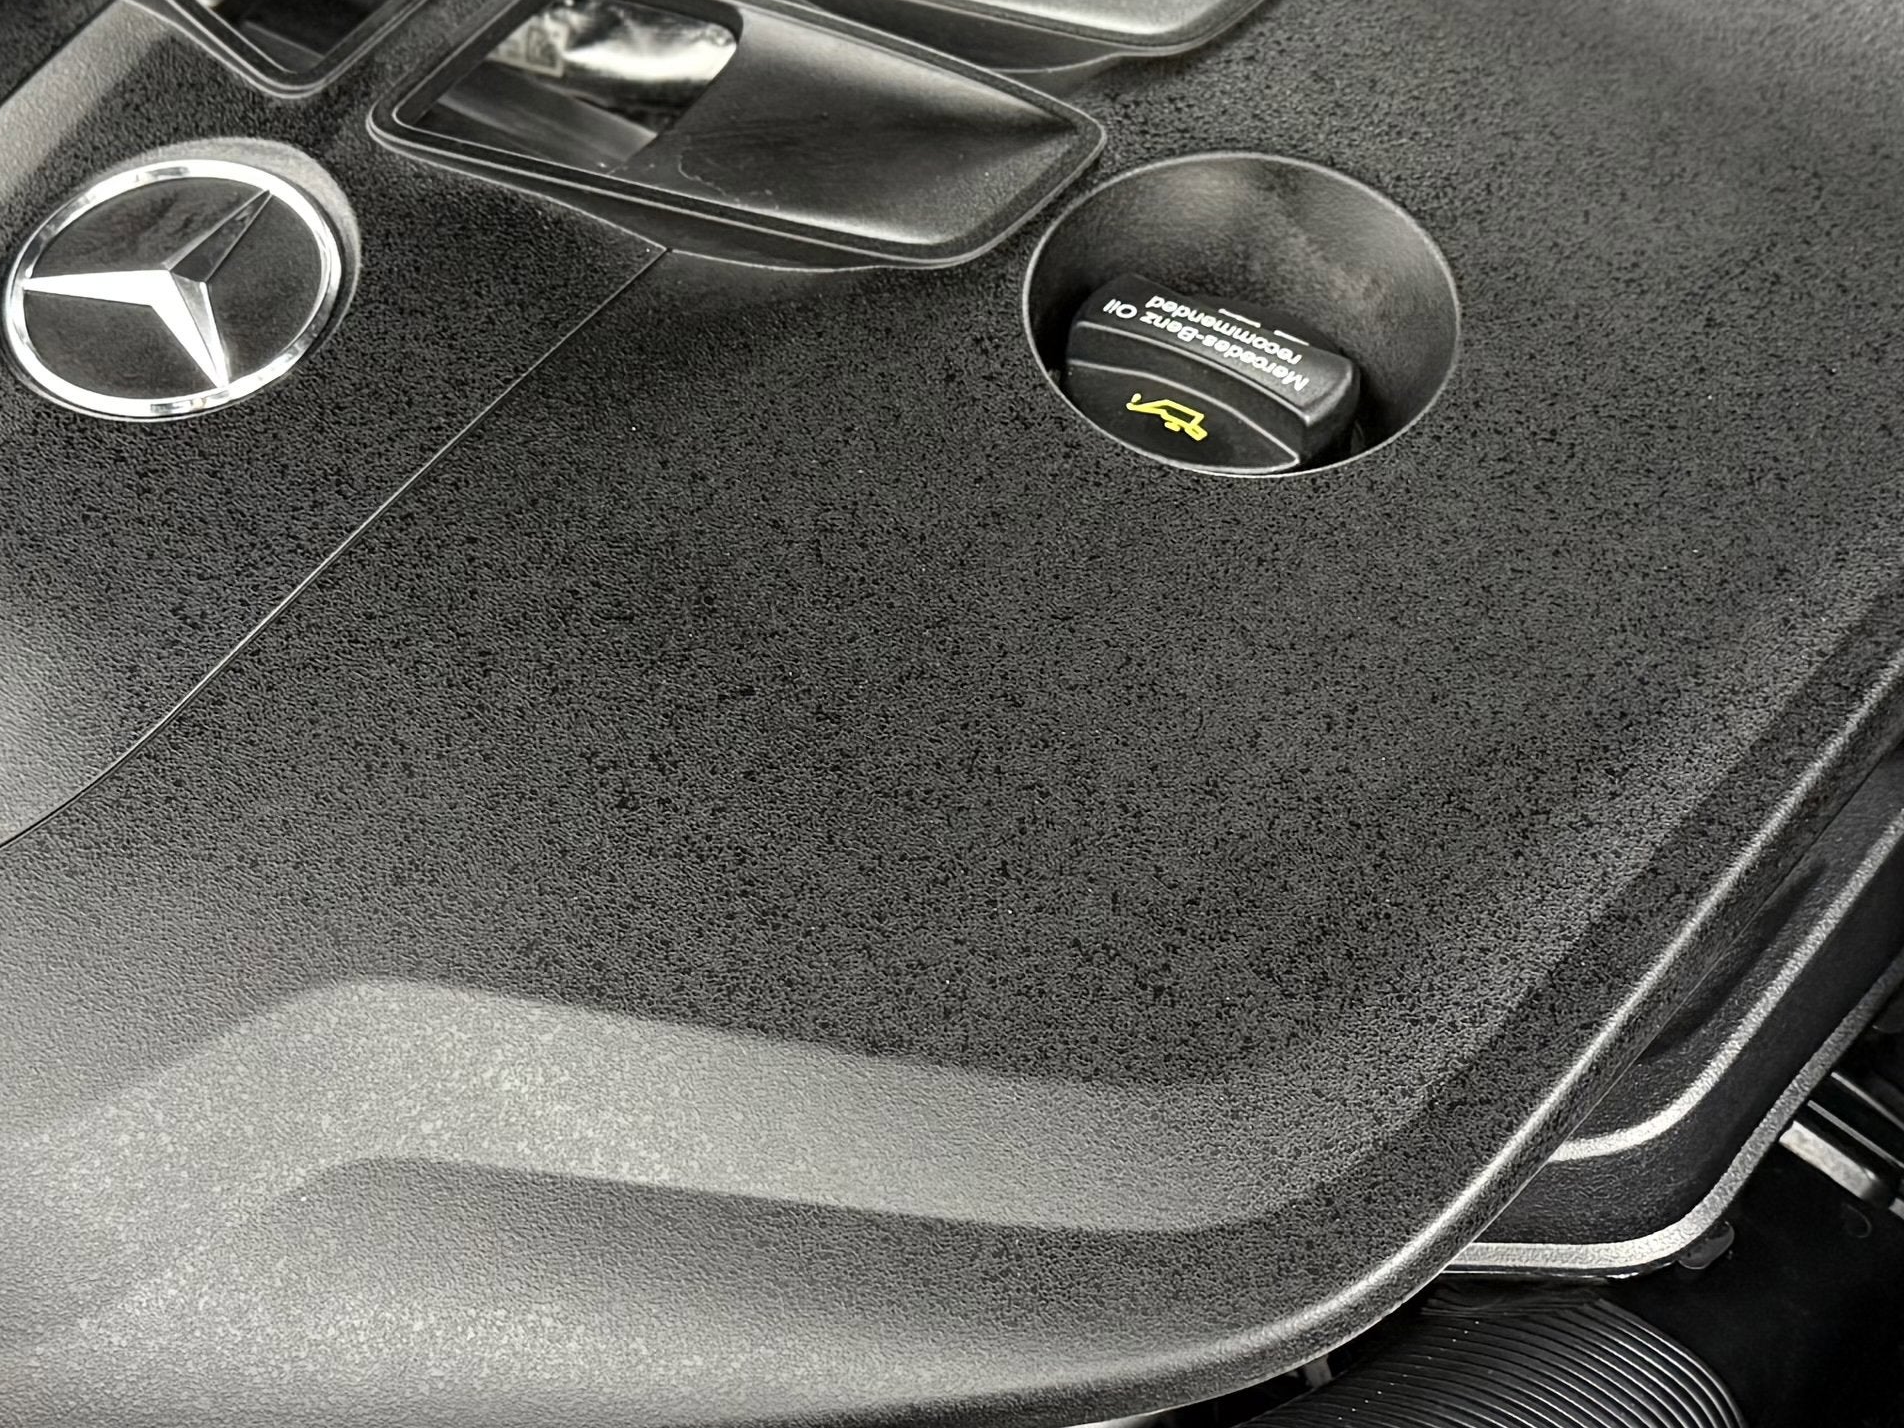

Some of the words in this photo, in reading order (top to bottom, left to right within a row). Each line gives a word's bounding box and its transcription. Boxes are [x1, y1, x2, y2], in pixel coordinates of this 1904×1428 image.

[1103, 298, 1137, 318] Oil
[1145, 295, 1301, 364] recommended
[1139, 311, 1310, 391] Mercedes-Benz
